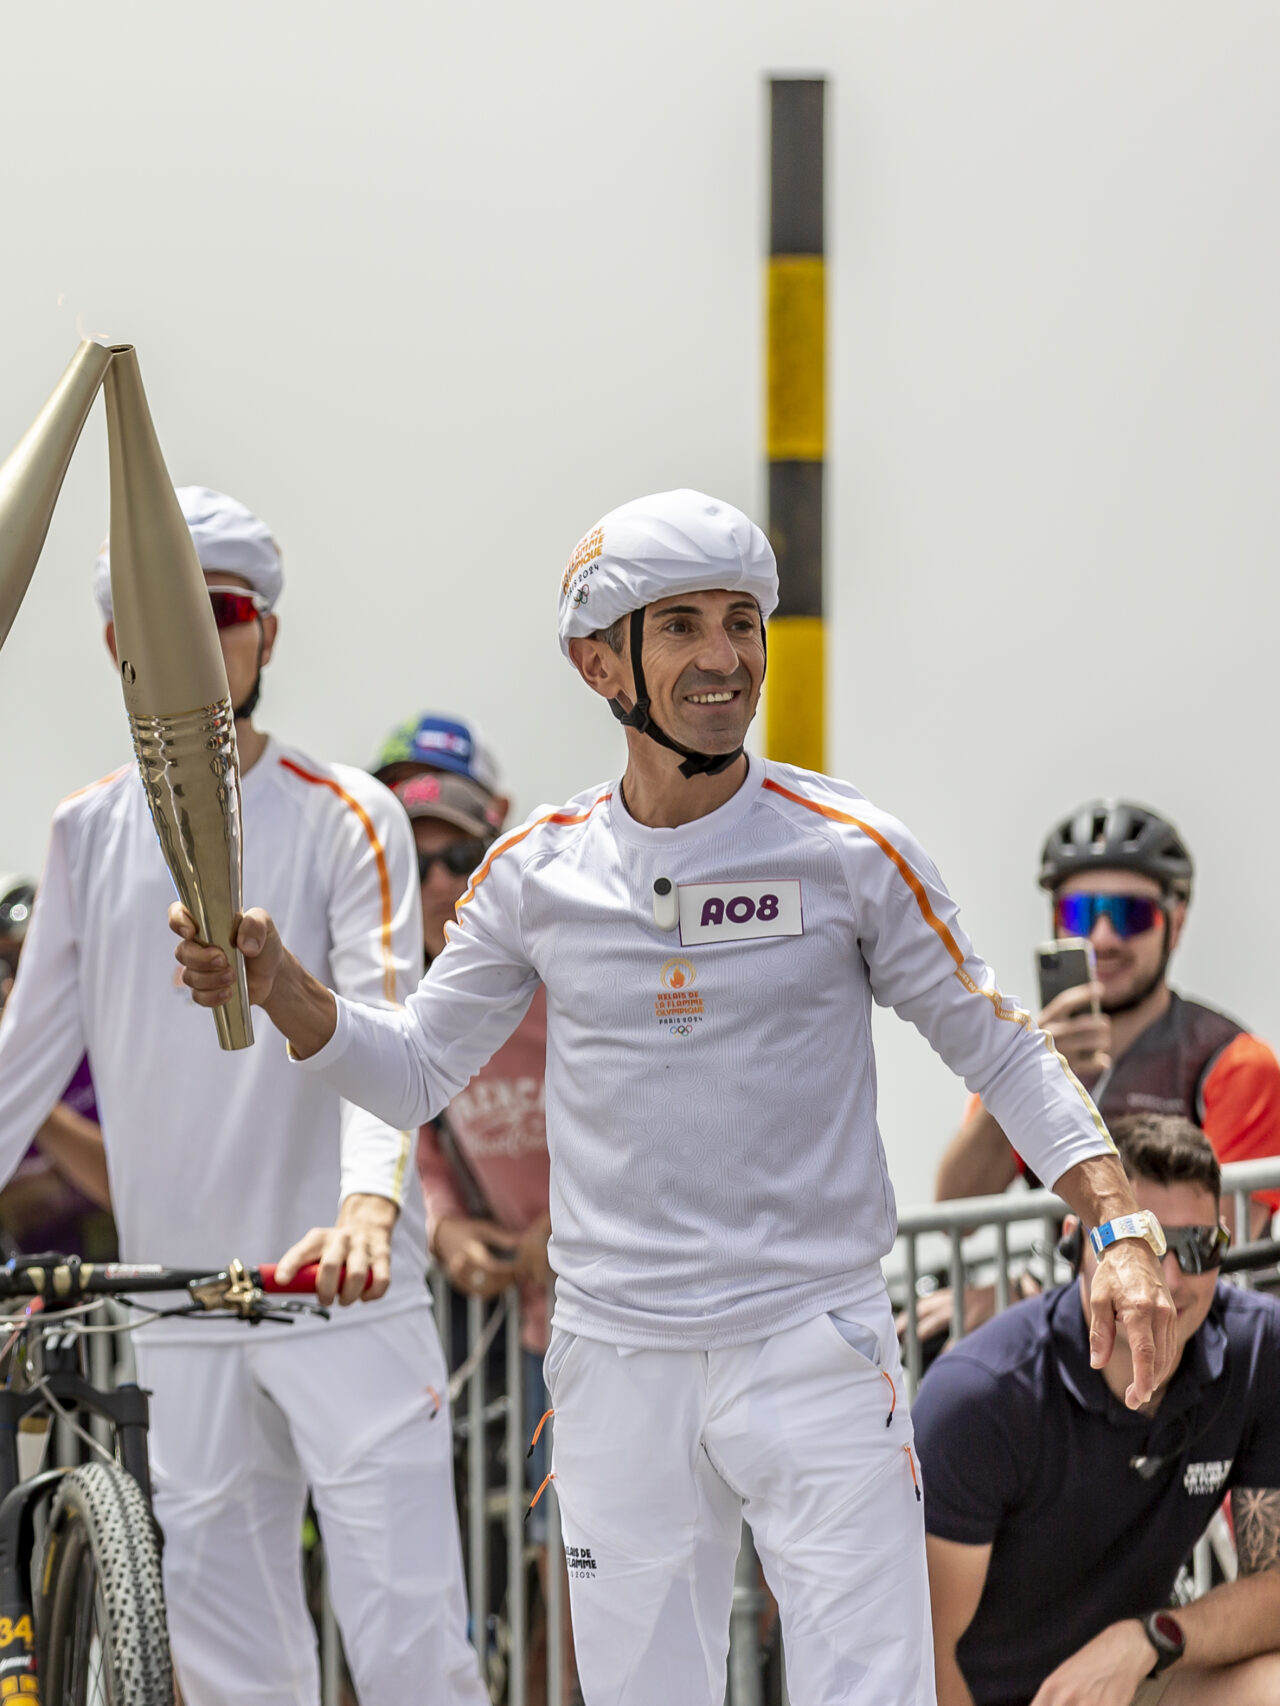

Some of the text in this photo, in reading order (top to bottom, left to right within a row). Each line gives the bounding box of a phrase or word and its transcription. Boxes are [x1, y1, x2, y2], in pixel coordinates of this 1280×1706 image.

[578, 563, 599, 582] 2024
[657, 991, 698, 1000] RELAIS DE
[654, 998, 703, 1008] LA FLAMME
[580, 1548, 592, 1558] DE
